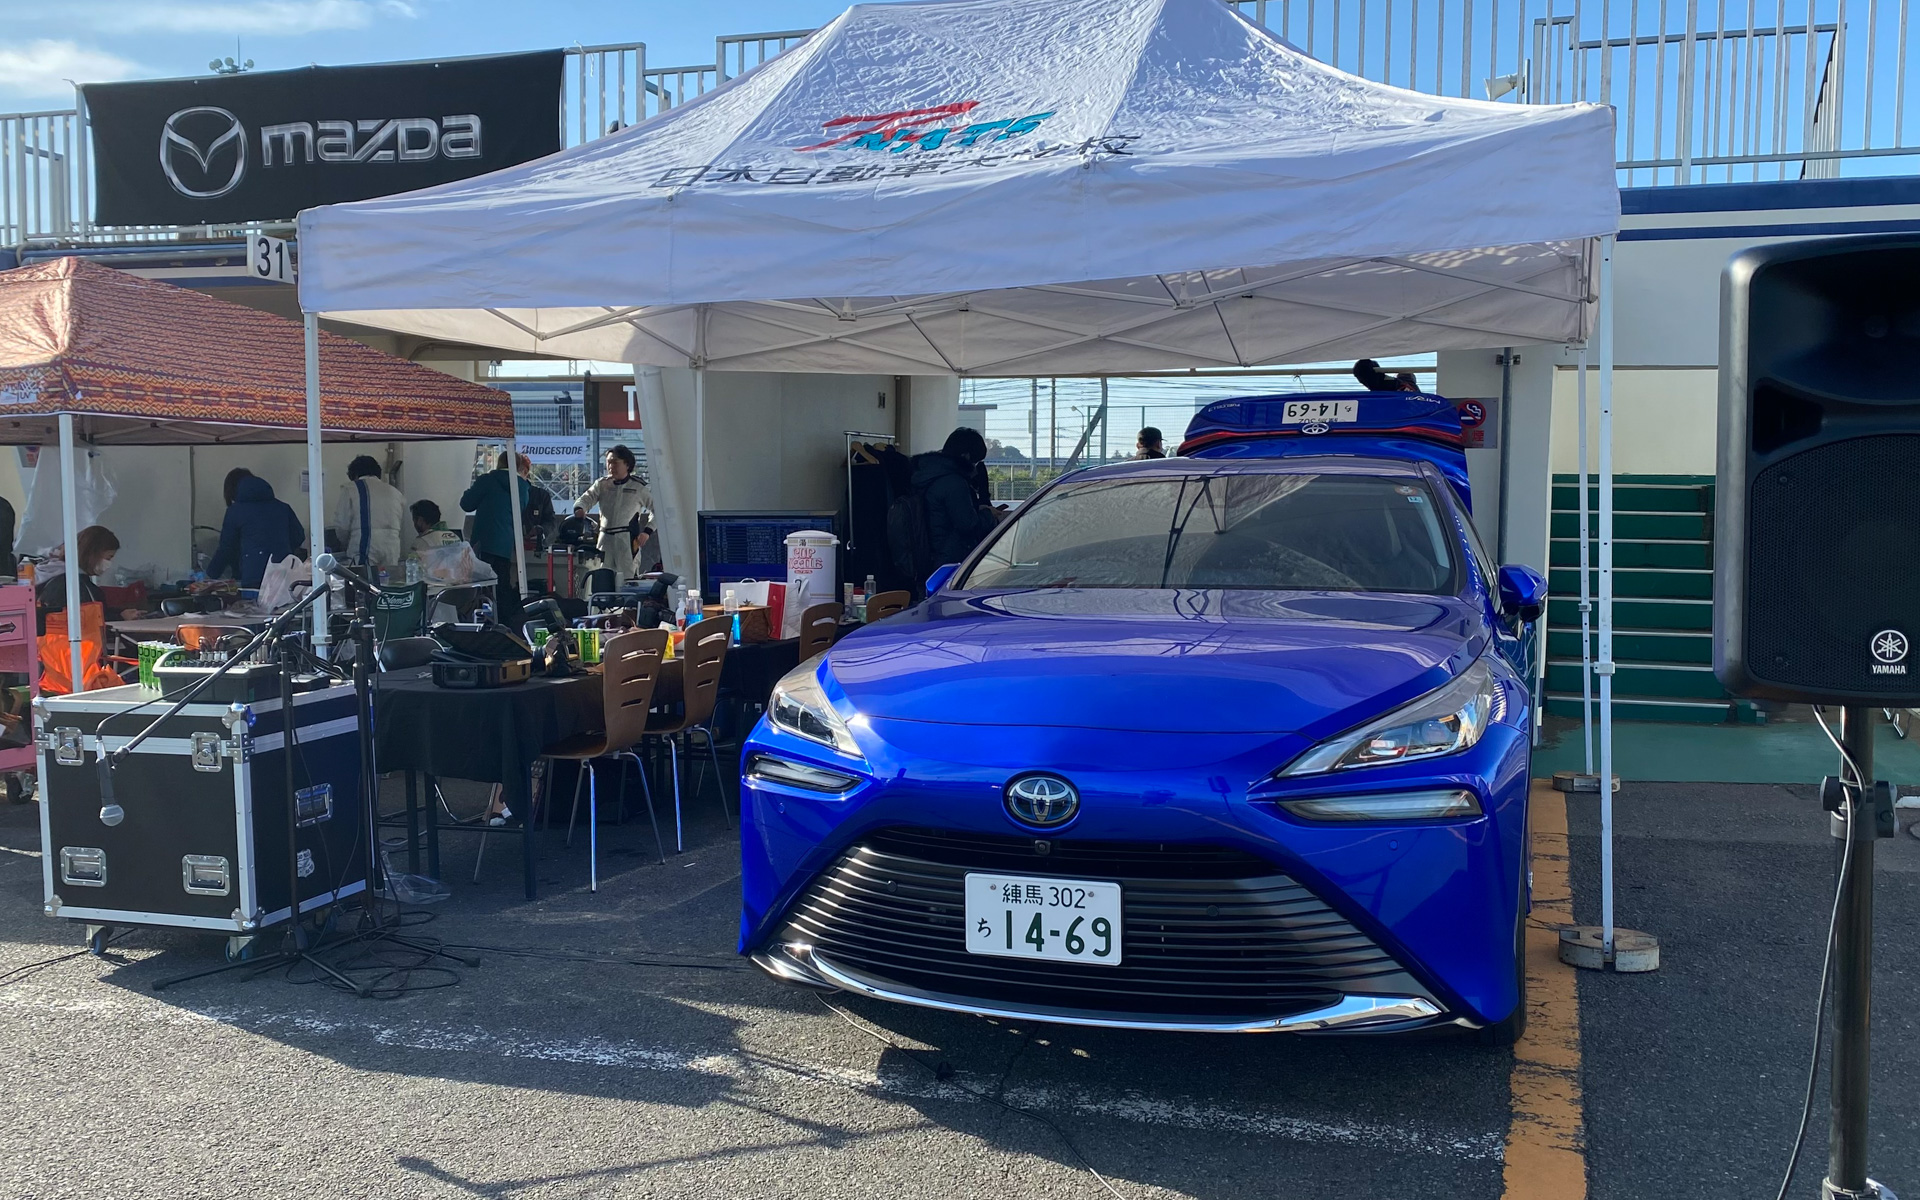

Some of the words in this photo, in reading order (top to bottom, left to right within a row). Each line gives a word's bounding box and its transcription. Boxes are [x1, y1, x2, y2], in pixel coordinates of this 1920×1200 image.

[846, 111, 1057, 153] NATS
[257, 237, 283, 279] 31
[1287, 402, 1339, 418] 14-69
[521, 445, 583, 455] BRIDGESTONE
[1872, 665, 1906, 674] YAMAHA
[1002, 883, 1043, 905] 練馬
[1049, 886, 1086, 909] 302
[977, 917, 991, 938] ち
[1006, 910, 1112, 957] 14-69
